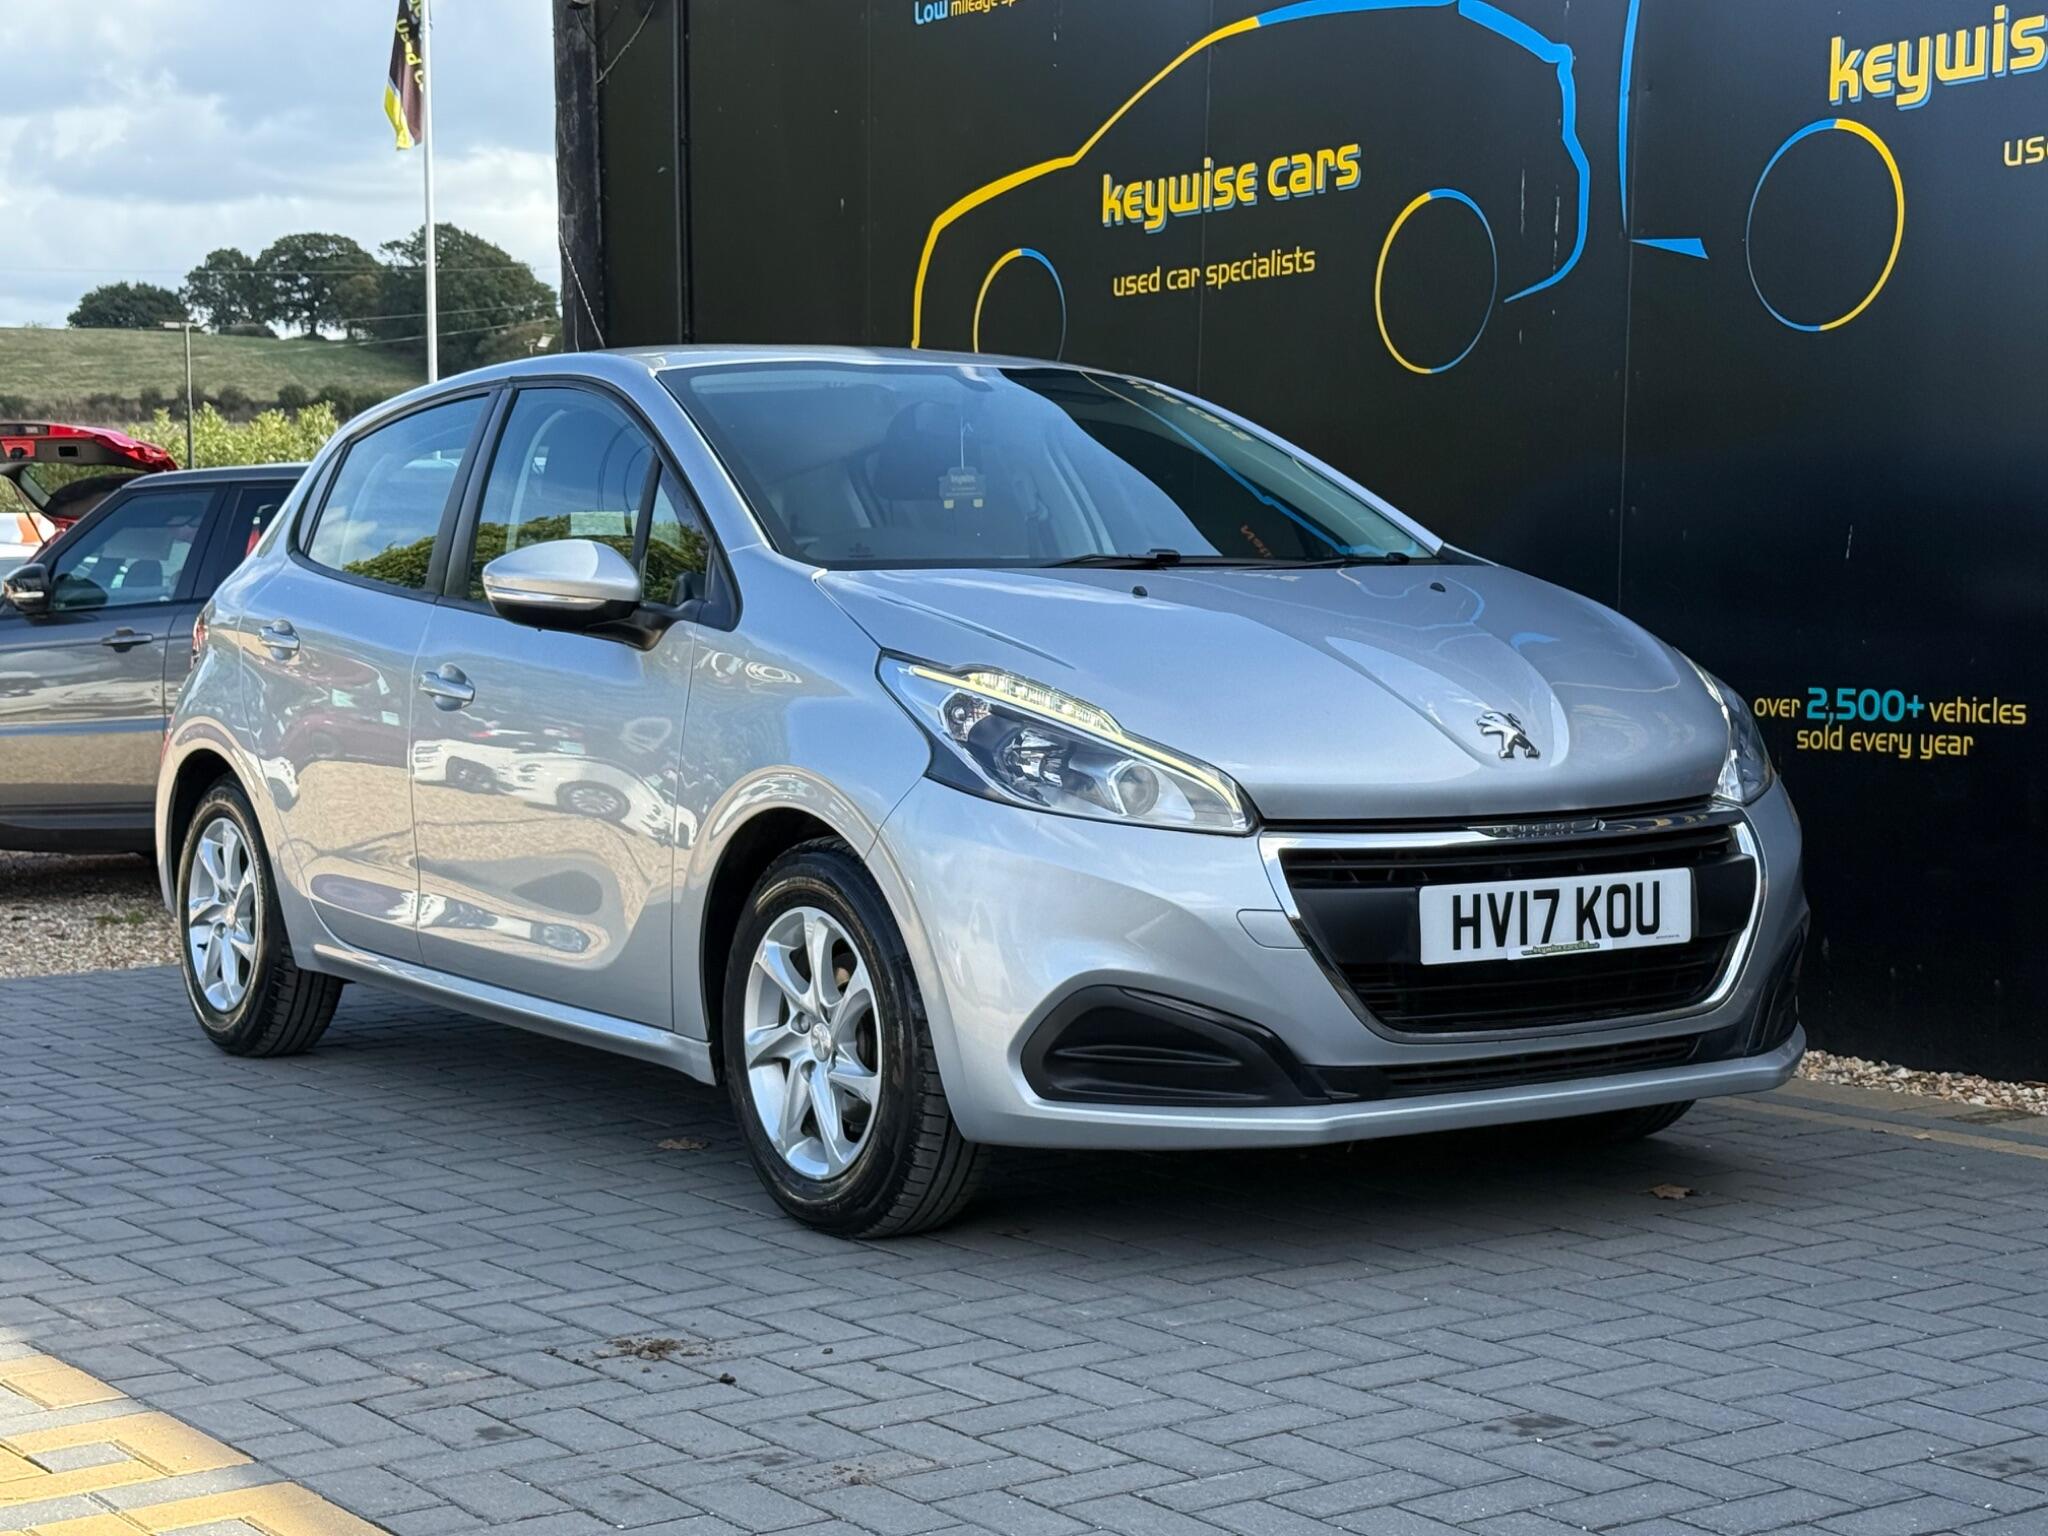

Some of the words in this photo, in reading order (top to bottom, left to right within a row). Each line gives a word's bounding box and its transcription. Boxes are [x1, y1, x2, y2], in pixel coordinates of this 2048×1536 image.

[914, 0, 949, 25] Low
[1828, 4, 2048, 110] keywis
[2003, 136, 2048, 167] us
[1102, 156, 1258, 234] keywise
[1266, 143, 1362, 201] cars
[1113, 266, 1160, 297] used
[1166, 266, 1201, 291] car
[1205, 246, 1316, 289] specialists
[1753, 697, 1801, 718] over
[1806, 687, 1925, 725] 2,500+
[1929, 696, 2027, 725] vehicles
[1796, 725, 1843, 750] sold
[1850, 731, 1911, 759] every
[1920, 734, 1974, 760] year
[1452, 888, 1560, 951] HV17
[1576, 880, 1661, 942] KOU
